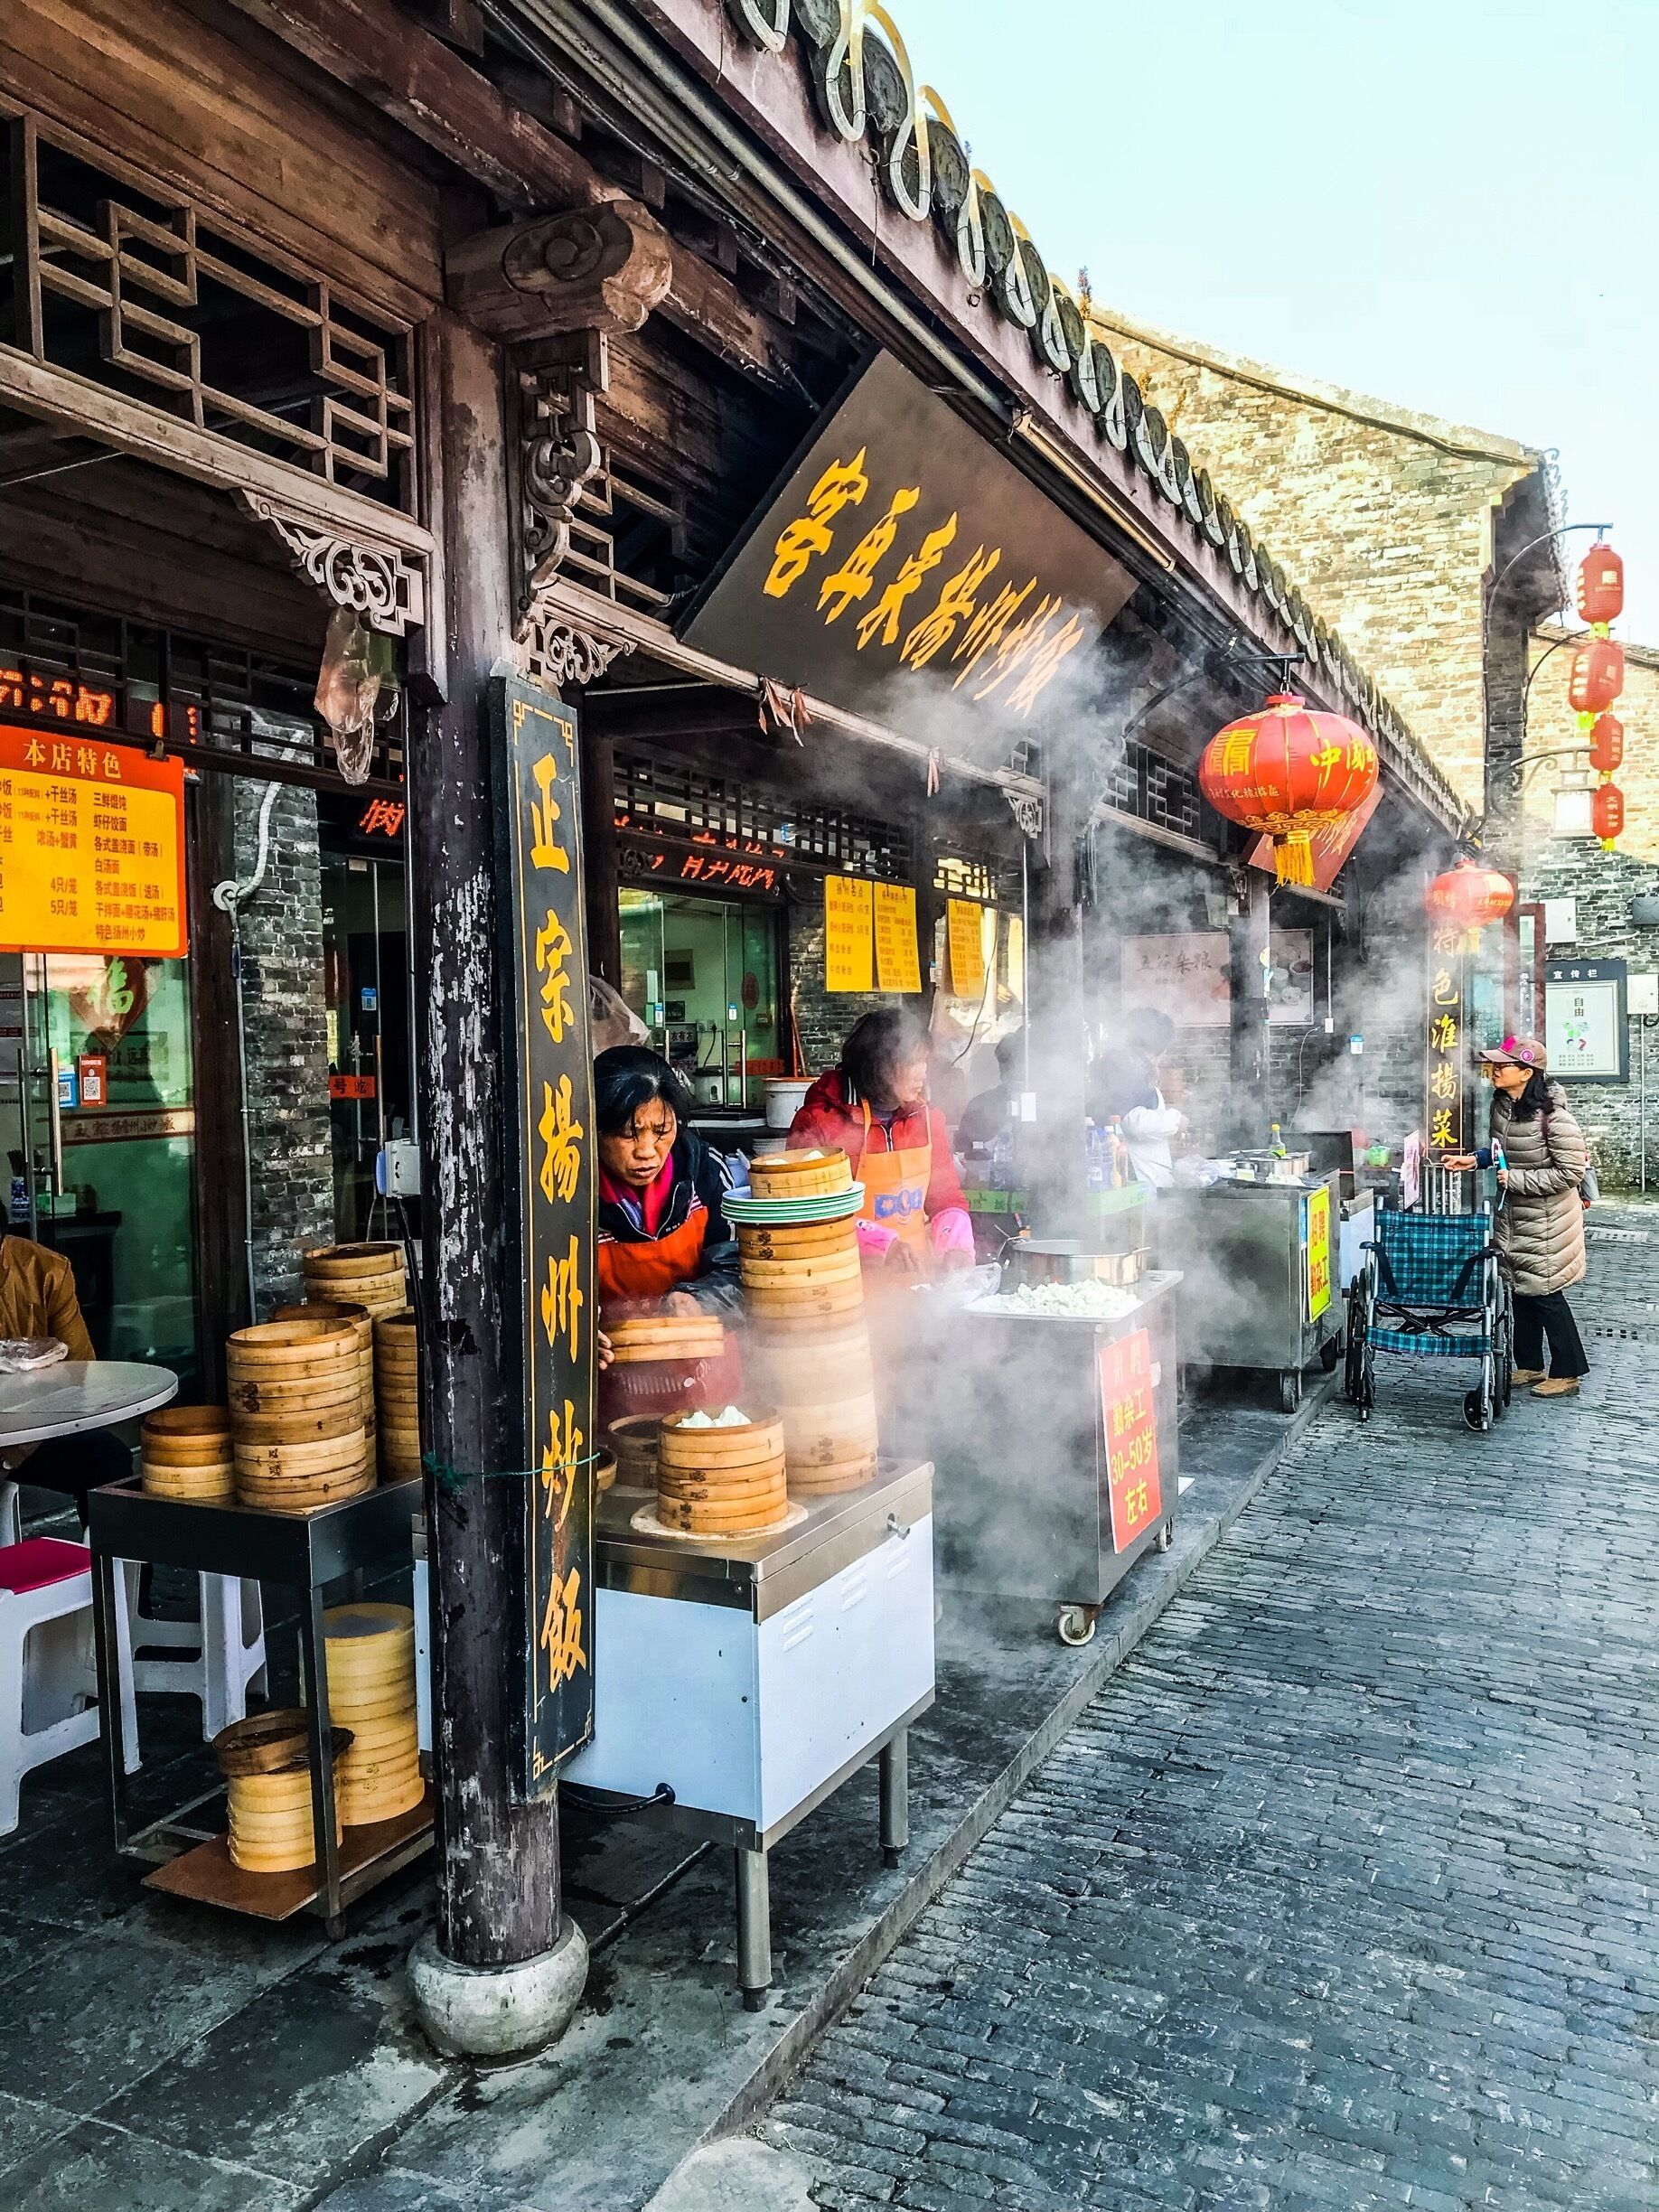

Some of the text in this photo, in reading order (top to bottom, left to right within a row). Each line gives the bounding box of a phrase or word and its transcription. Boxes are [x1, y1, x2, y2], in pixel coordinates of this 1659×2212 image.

[23, 737, 122, 779] 本店特色
[93, 792, 127, 811] 三鲜馄饨
[94, 858, 120, 876] 白汤面
[50, 876, 78, 895] 4只/笼
[50, 900, 79, 917] 5只/笼
[95, 923, 145, 942] 特色扬州小炒
[1552, 969, 1598, 979] 宣传栏
[88, 955, 134, 1016] 福
[1574, 998, 1585, 1017] 自由
[1112, 1385, 1148, 1438] 勤杂工
[1111, 1423, 1154, 1486] 30-50岁
[1124, 1477, 1148, 1526] 左右
